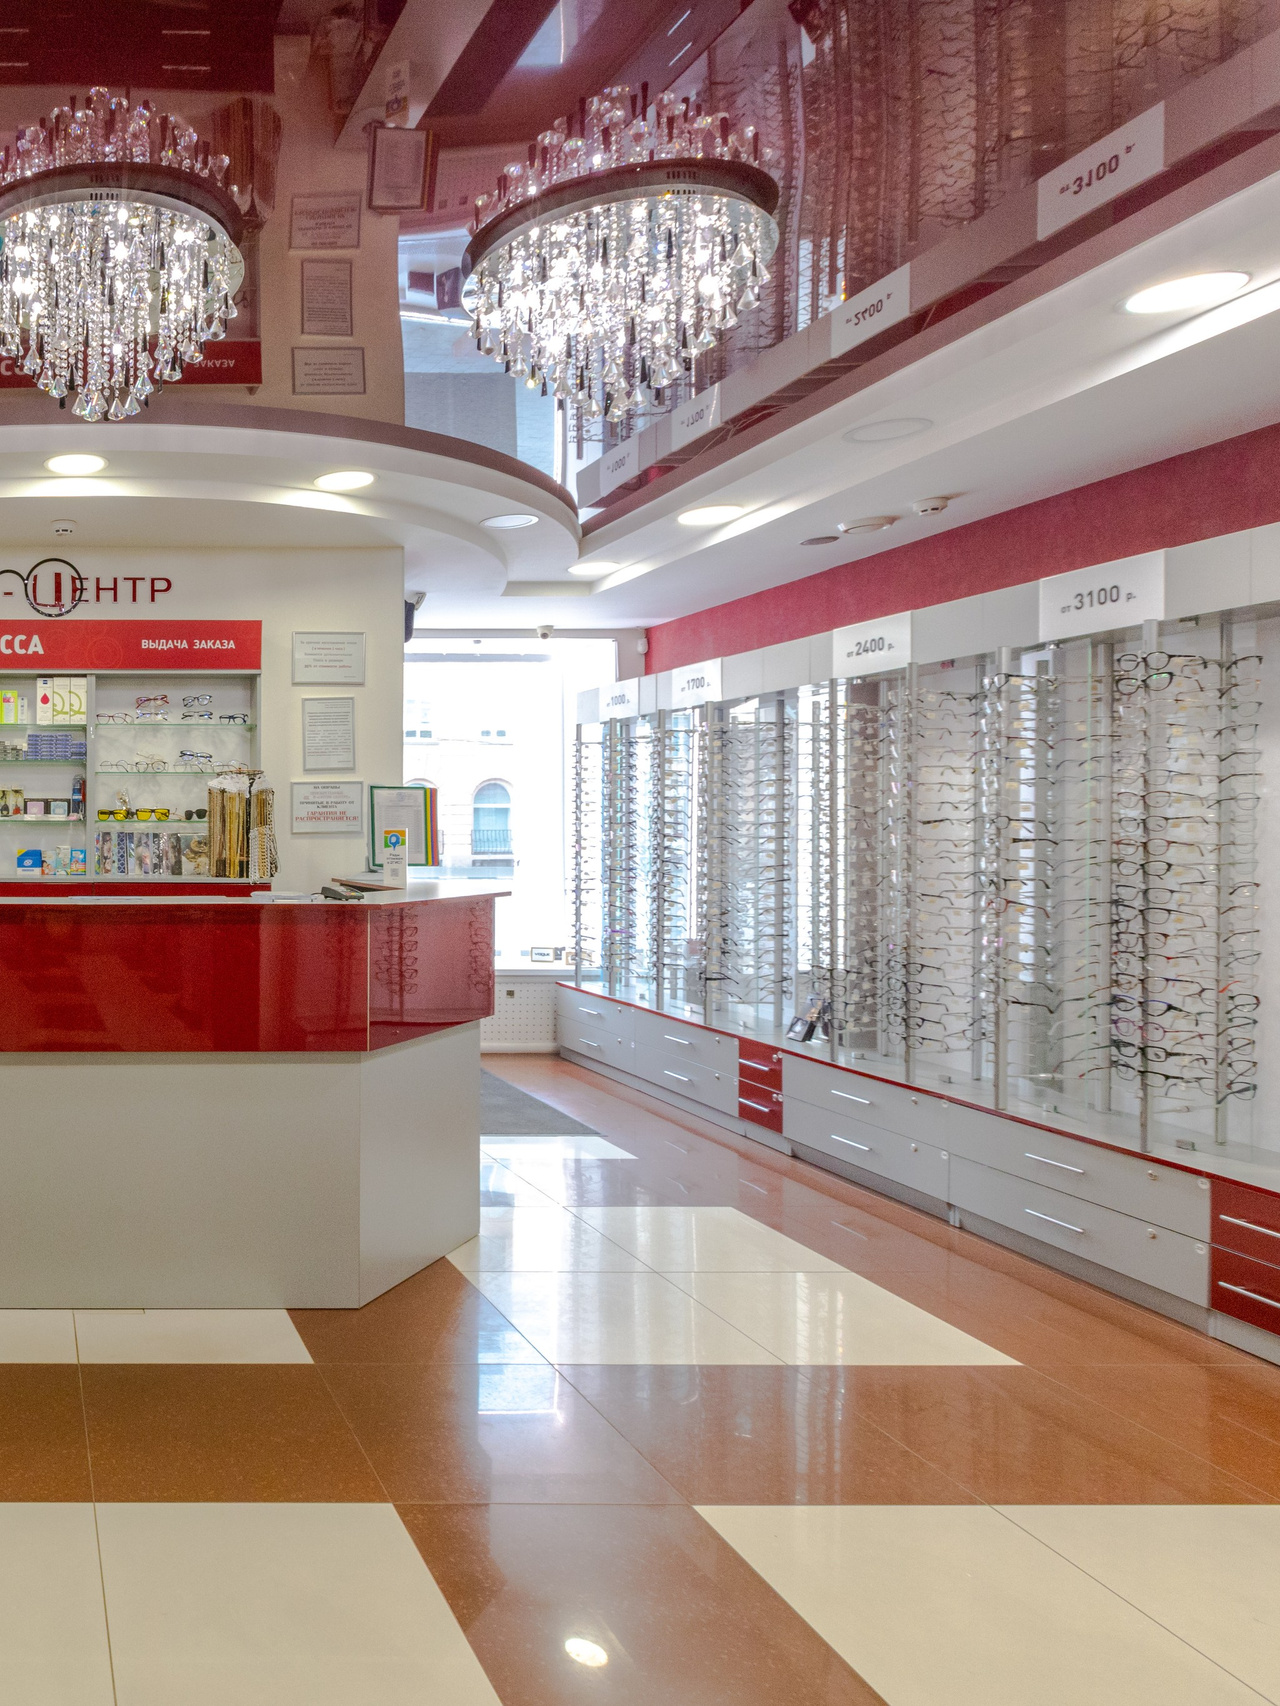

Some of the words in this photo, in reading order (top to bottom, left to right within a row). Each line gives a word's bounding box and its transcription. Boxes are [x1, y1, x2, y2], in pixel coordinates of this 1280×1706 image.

[1074, 585, 1120, 610] 3100
[141, 639, 188, 650] ВЫДАЧА
[193, 639, 236, 649] ЗАКАЗА
[855, 637, 885, 656] 2400
[686, 676, 705, 690] 1700
[611, 694, 626, 706] 1000
